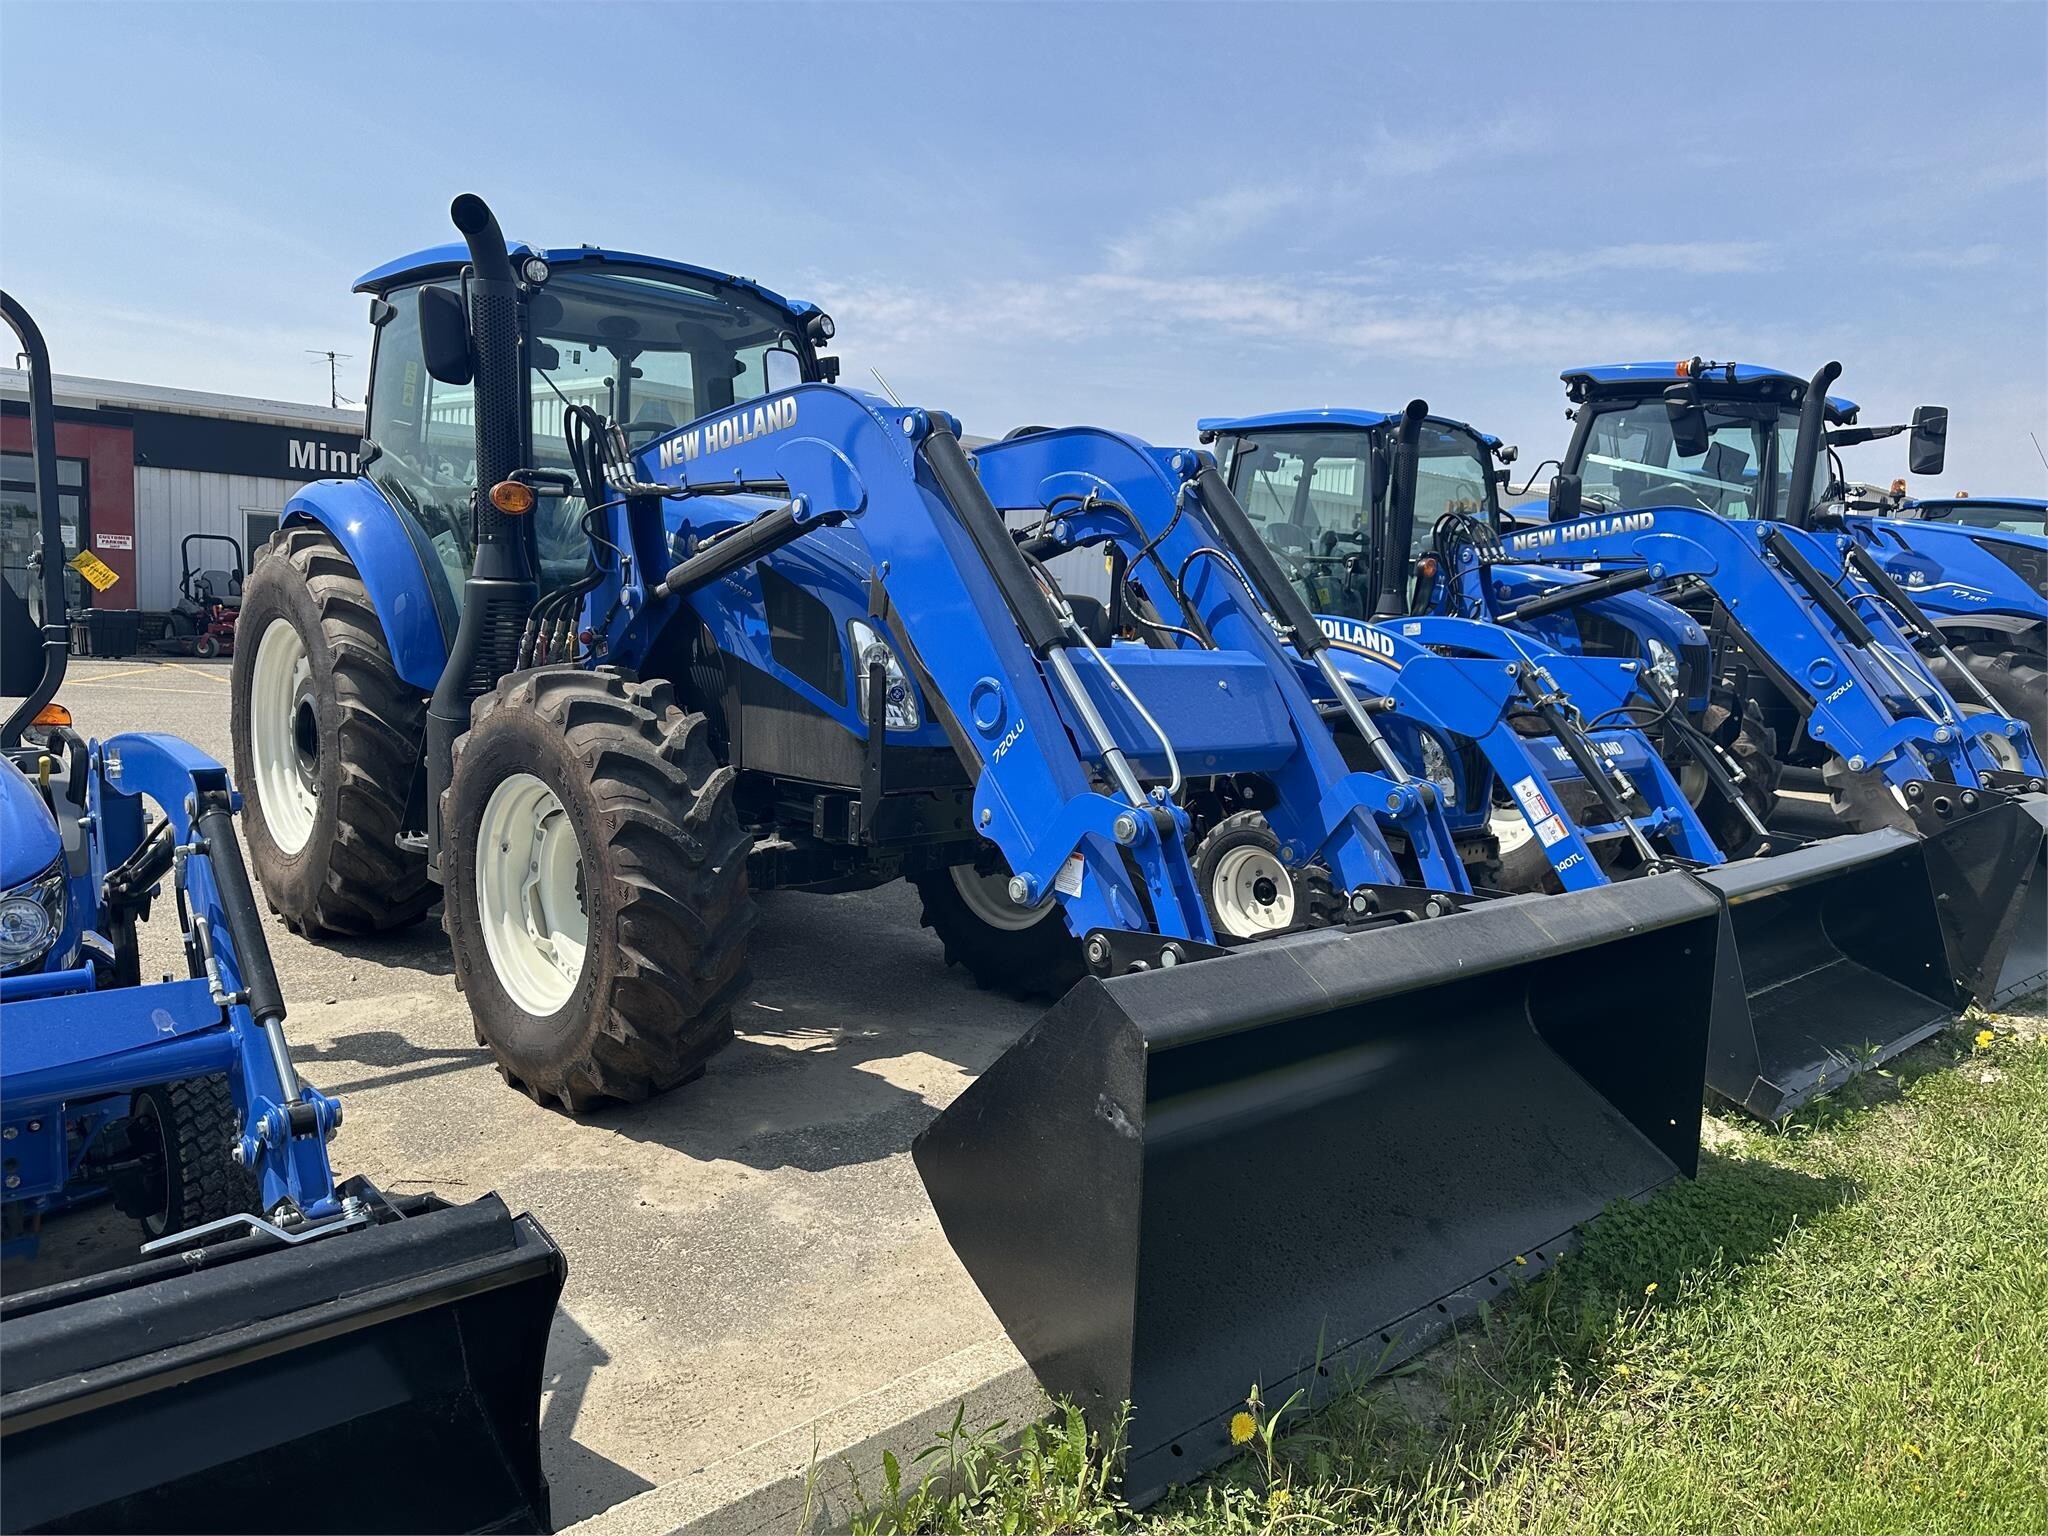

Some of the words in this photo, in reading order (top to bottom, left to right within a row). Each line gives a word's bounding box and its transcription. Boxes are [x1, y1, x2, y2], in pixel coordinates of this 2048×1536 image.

[659, 430, 700, 470] NEW
[705, 396, 797, 455] HOLLAND
[1513, 529, 1556, 551] NEW
[1561, 512, 1655, 543] HOLLAND
[1317, 619, 1395, 658] OLLAND
[1826, 679, 1853, 704] 720LU
[992, 718, 1025, 764] 720LU
[1554, 853, 1585, 873] 140TL
